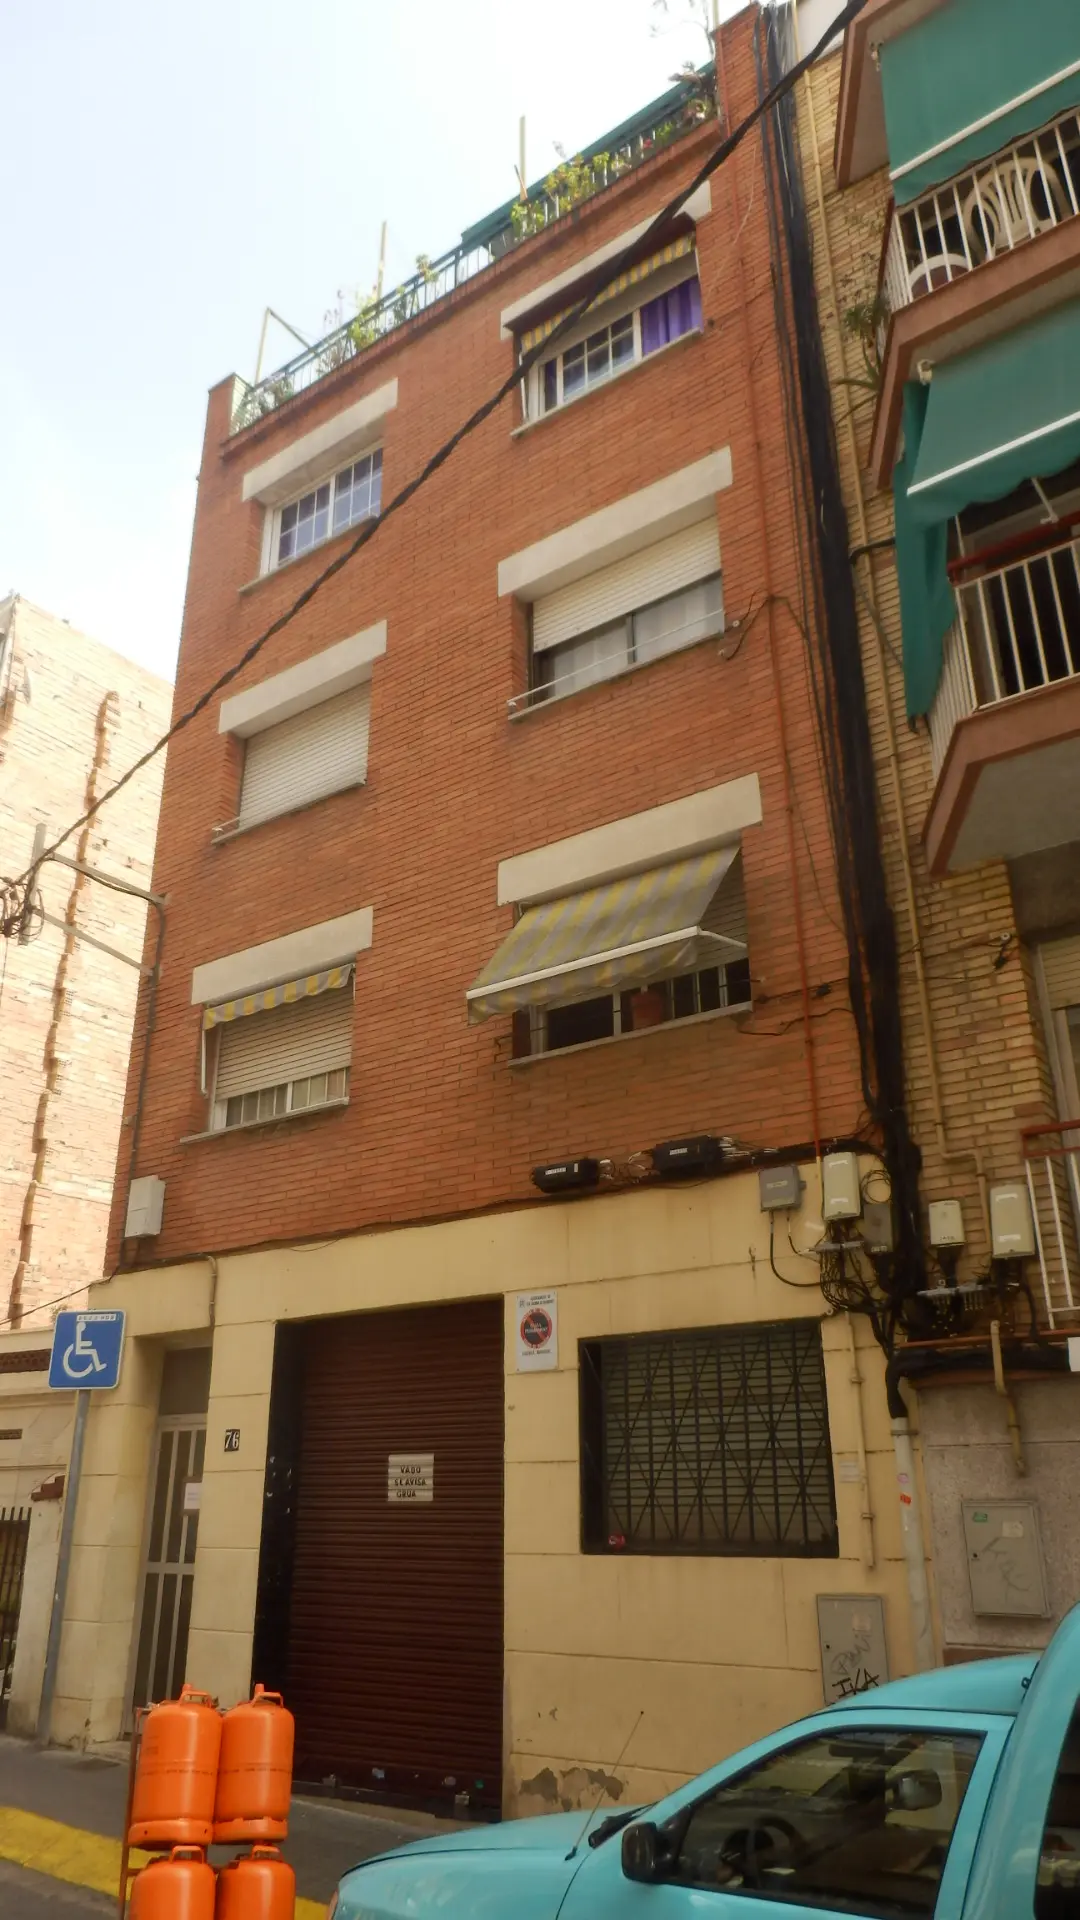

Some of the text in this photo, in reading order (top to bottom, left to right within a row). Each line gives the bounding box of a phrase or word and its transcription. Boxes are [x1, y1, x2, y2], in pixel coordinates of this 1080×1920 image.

[225, 1431, 240, 1449] 76
[400, 1465, 421, 1474] VADO
[405, 1477, 427, 1486] AVISA
[396, 1489, 417, 1498] GRUA
